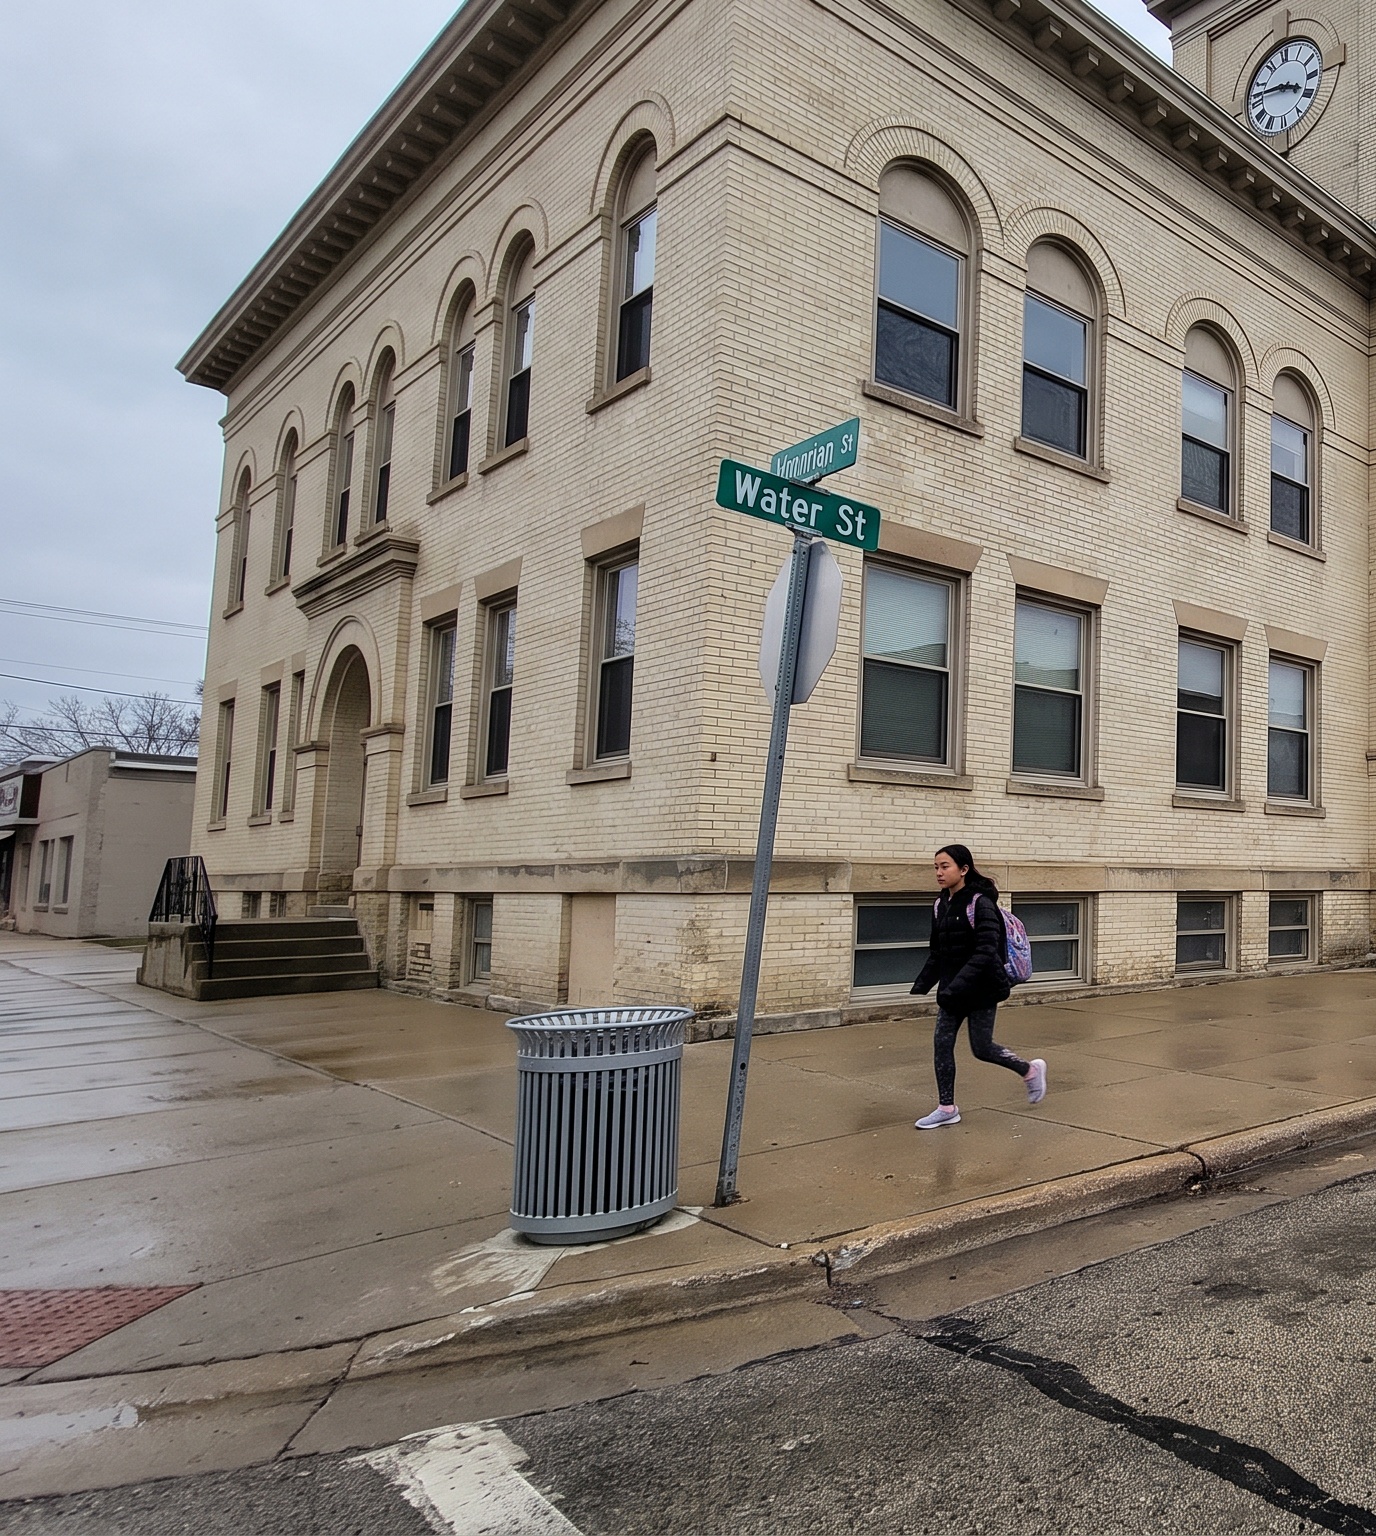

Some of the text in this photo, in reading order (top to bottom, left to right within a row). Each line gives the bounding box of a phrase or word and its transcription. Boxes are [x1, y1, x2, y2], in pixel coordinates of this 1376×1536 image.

[840, 433, 854, 454] St
[735, 469, 867, 541] Water St
